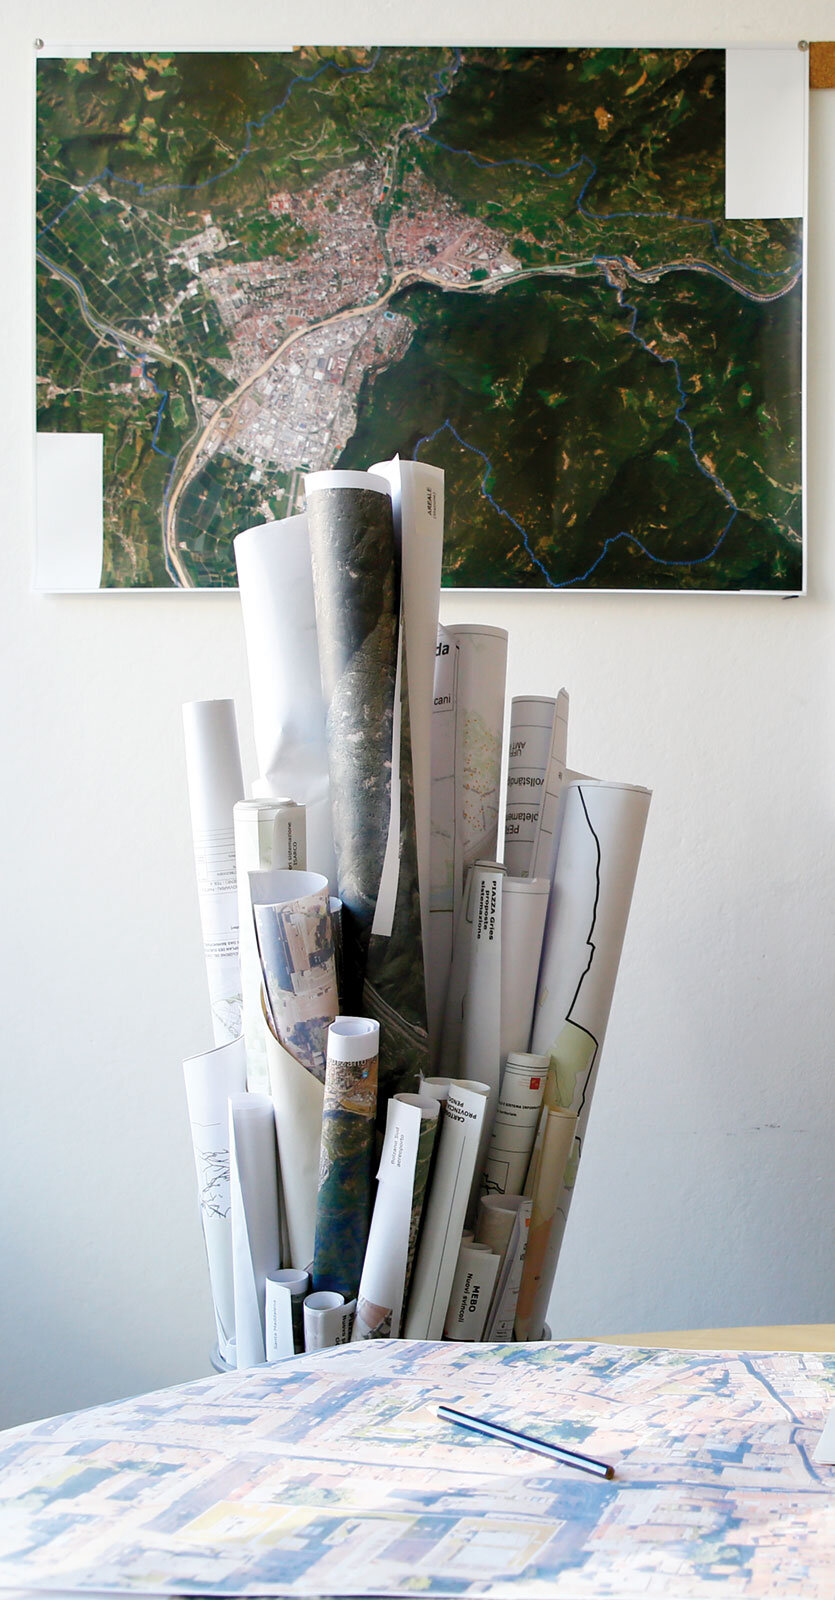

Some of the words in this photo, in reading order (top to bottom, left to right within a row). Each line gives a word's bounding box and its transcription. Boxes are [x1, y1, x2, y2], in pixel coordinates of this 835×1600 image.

[433, 694, 451, 706] cani
[477, 880, 486, 940] sistemazione
[488, 917, 496, 940] Gries
[463, 1273, 473, 1294] Nuovi
[458, 1295, 468, 1323] svincoli
[468, 1285, 480, 1312] MEBO
